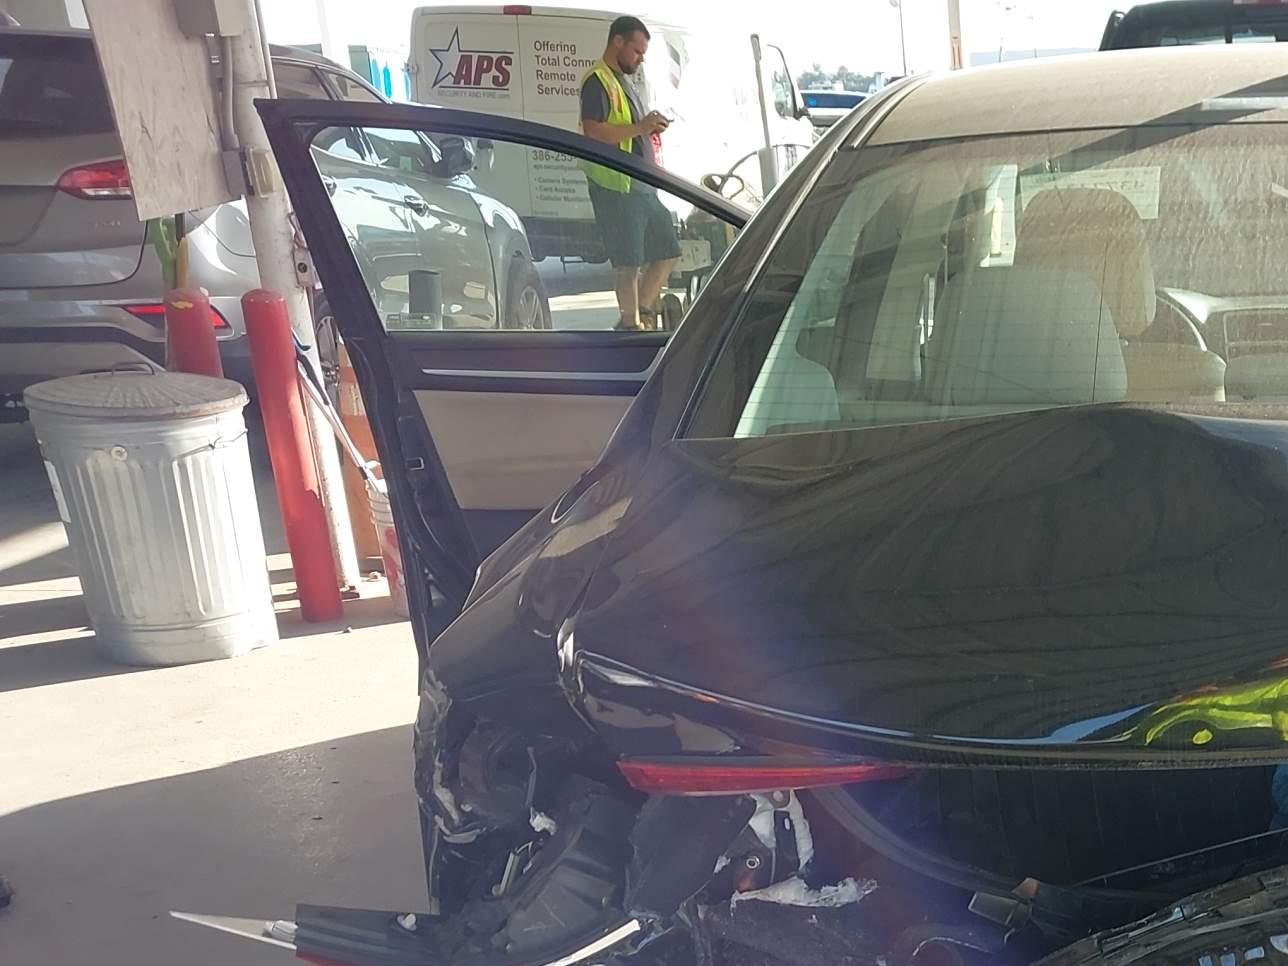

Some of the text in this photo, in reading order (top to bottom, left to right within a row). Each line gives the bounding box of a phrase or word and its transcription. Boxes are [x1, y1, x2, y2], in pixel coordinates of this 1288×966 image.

[534, 40, 576, 54] Offering
[535, 55, 560, 66] Total
[453, 54, 512, 87] APS
[536, 69, 576, 82] Remote
